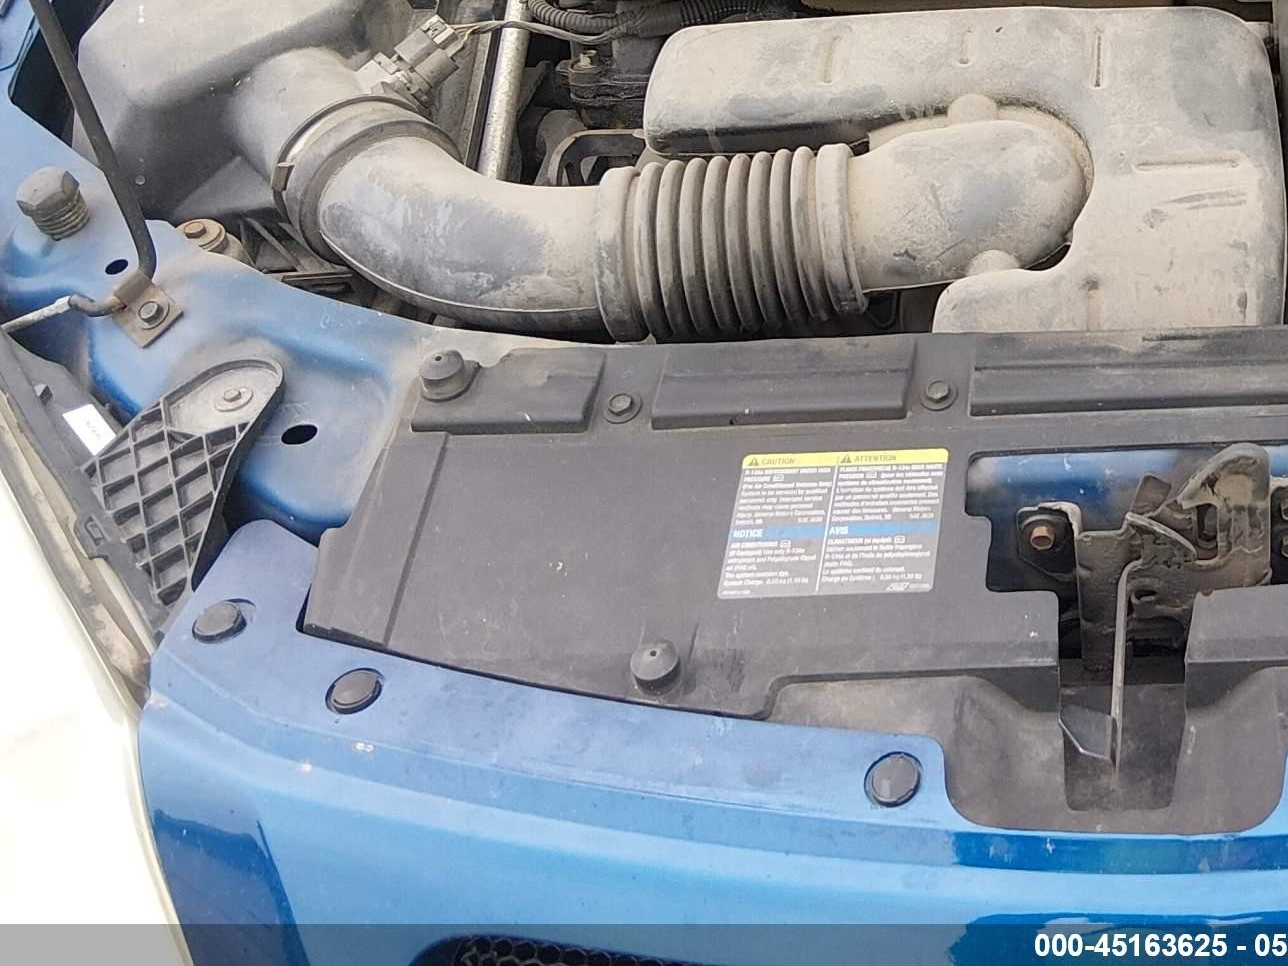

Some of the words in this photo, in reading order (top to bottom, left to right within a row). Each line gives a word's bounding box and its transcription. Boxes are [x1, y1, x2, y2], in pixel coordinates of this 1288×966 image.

[761, 458, 796, 466] CAUTION
[854, 454, 897, 463] ATTENTION
[733, 528, 763, 538] NOTICE
[828, 526, 849, 535] AVIS
